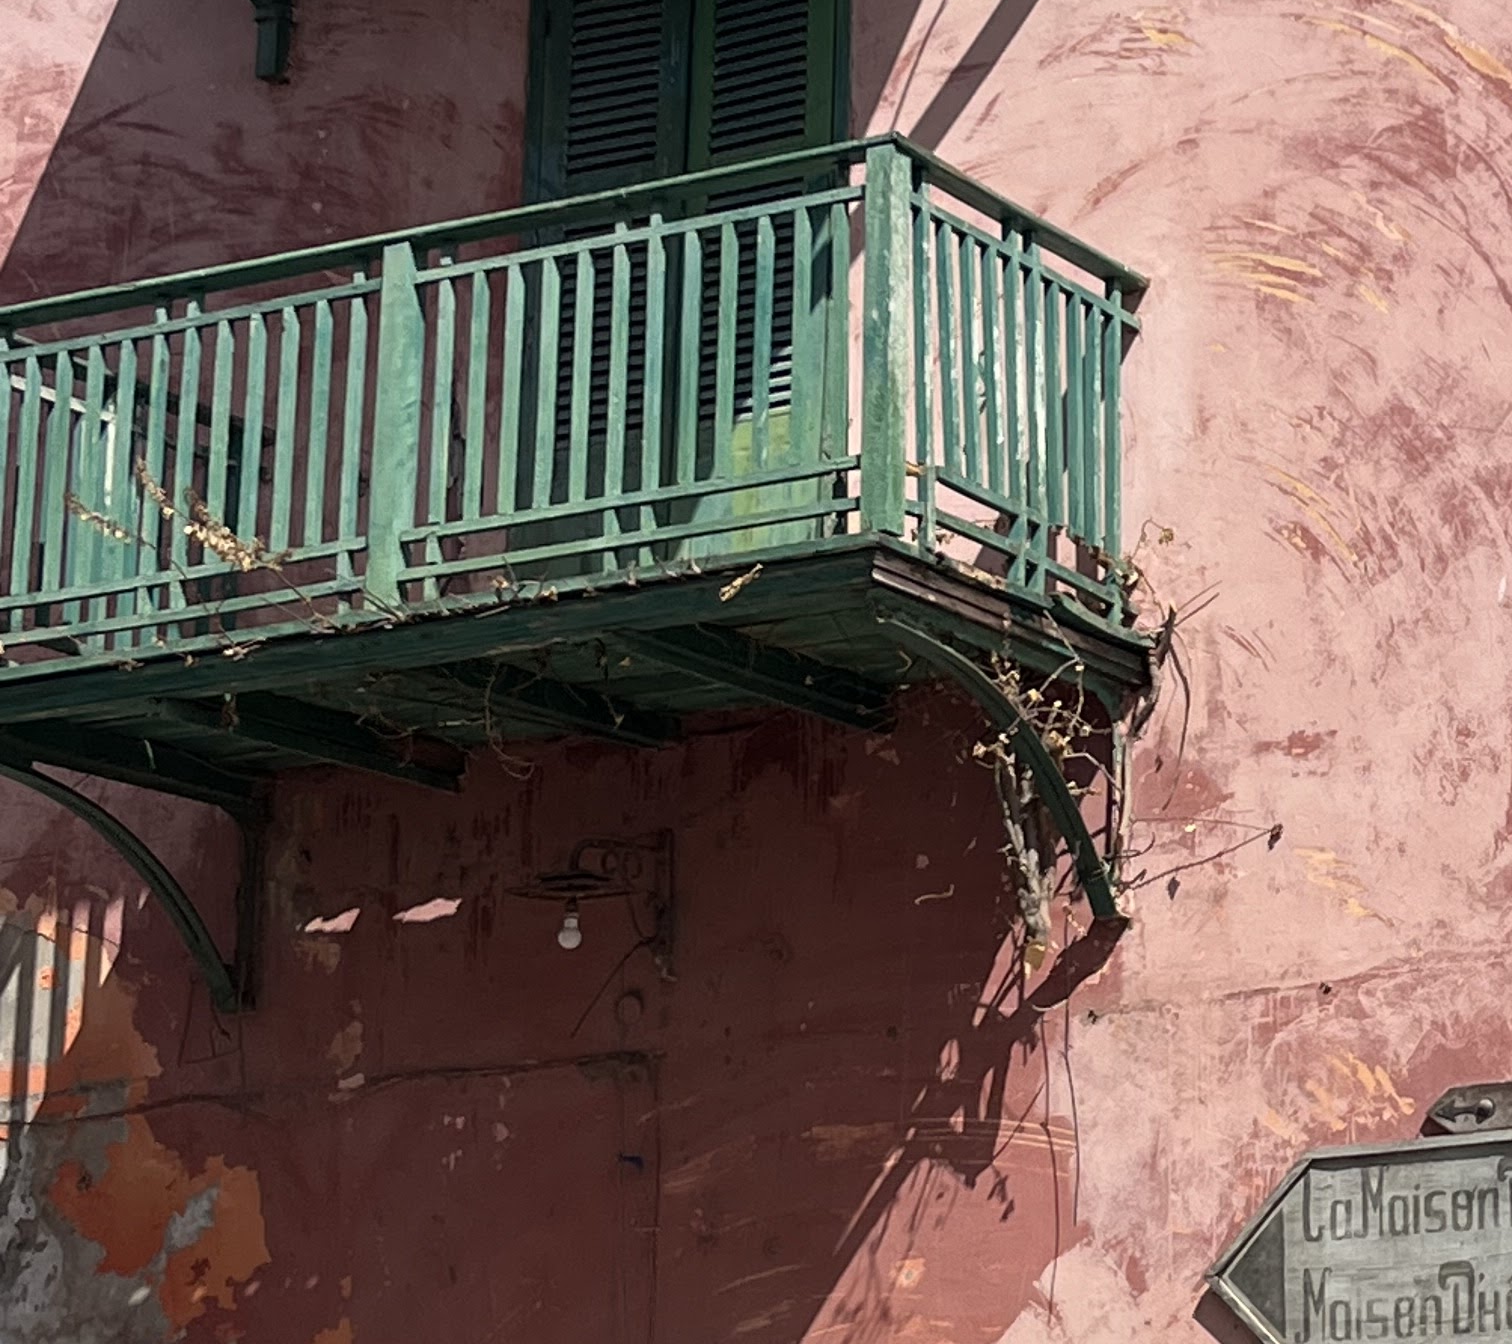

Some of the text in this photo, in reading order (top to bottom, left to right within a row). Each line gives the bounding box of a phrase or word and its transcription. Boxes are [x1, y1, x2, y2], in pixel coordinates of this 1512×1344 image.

[1302, 1171, 1353, 1242] La
[1354, 1165, 1500, 1238] Maison
[1294, 1266, 1443, 1344] Maison
